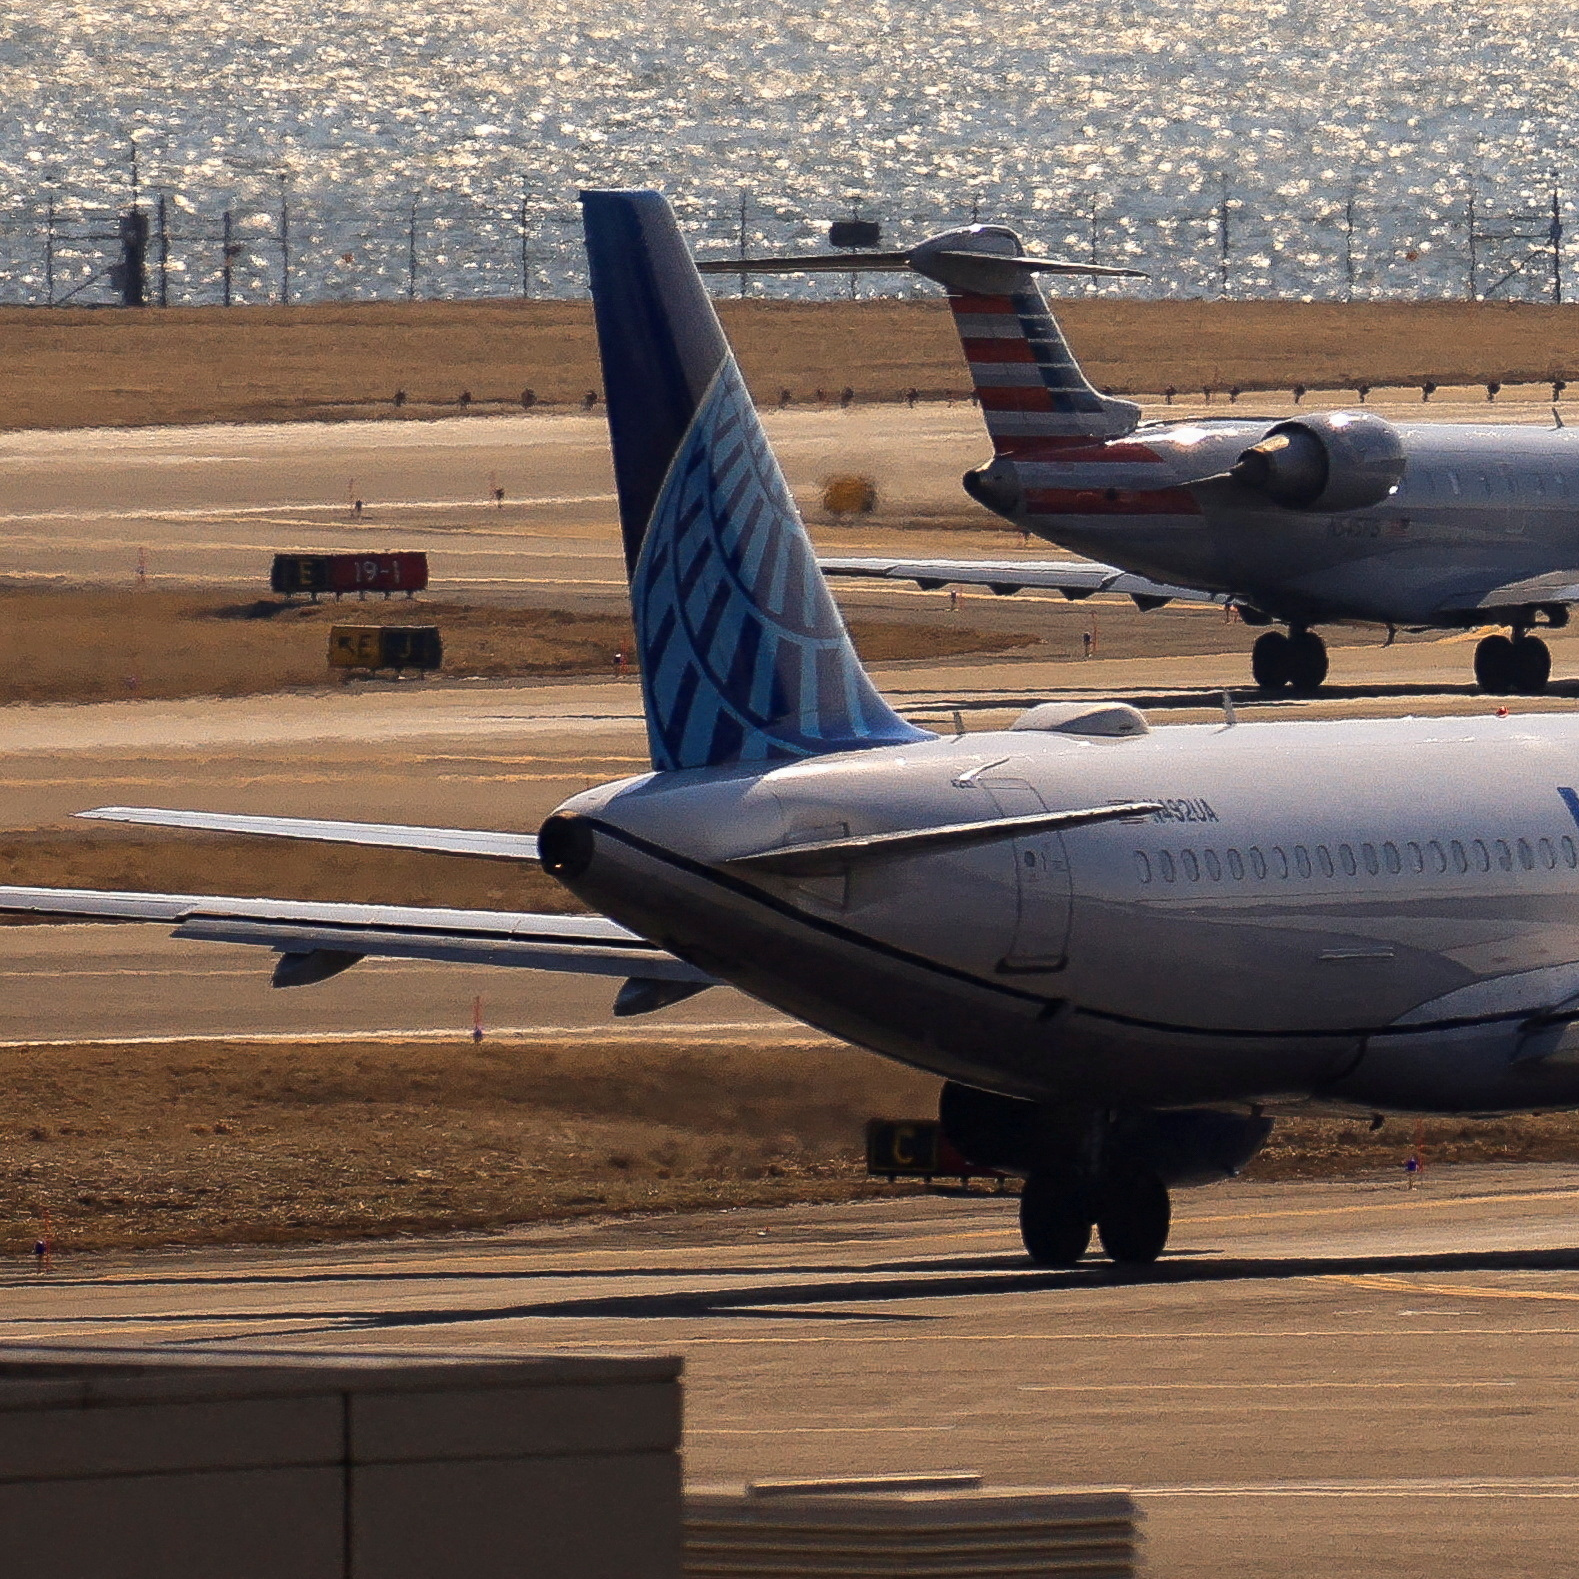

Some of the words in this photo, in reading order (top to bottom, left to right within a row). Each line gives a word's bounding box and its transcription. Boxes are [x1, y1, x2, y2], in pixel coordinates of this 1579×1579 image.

[301, 561, 314, 585] E
[354, 560, 401, 584] 19-1
[893, 1127, 914, 1164] C
